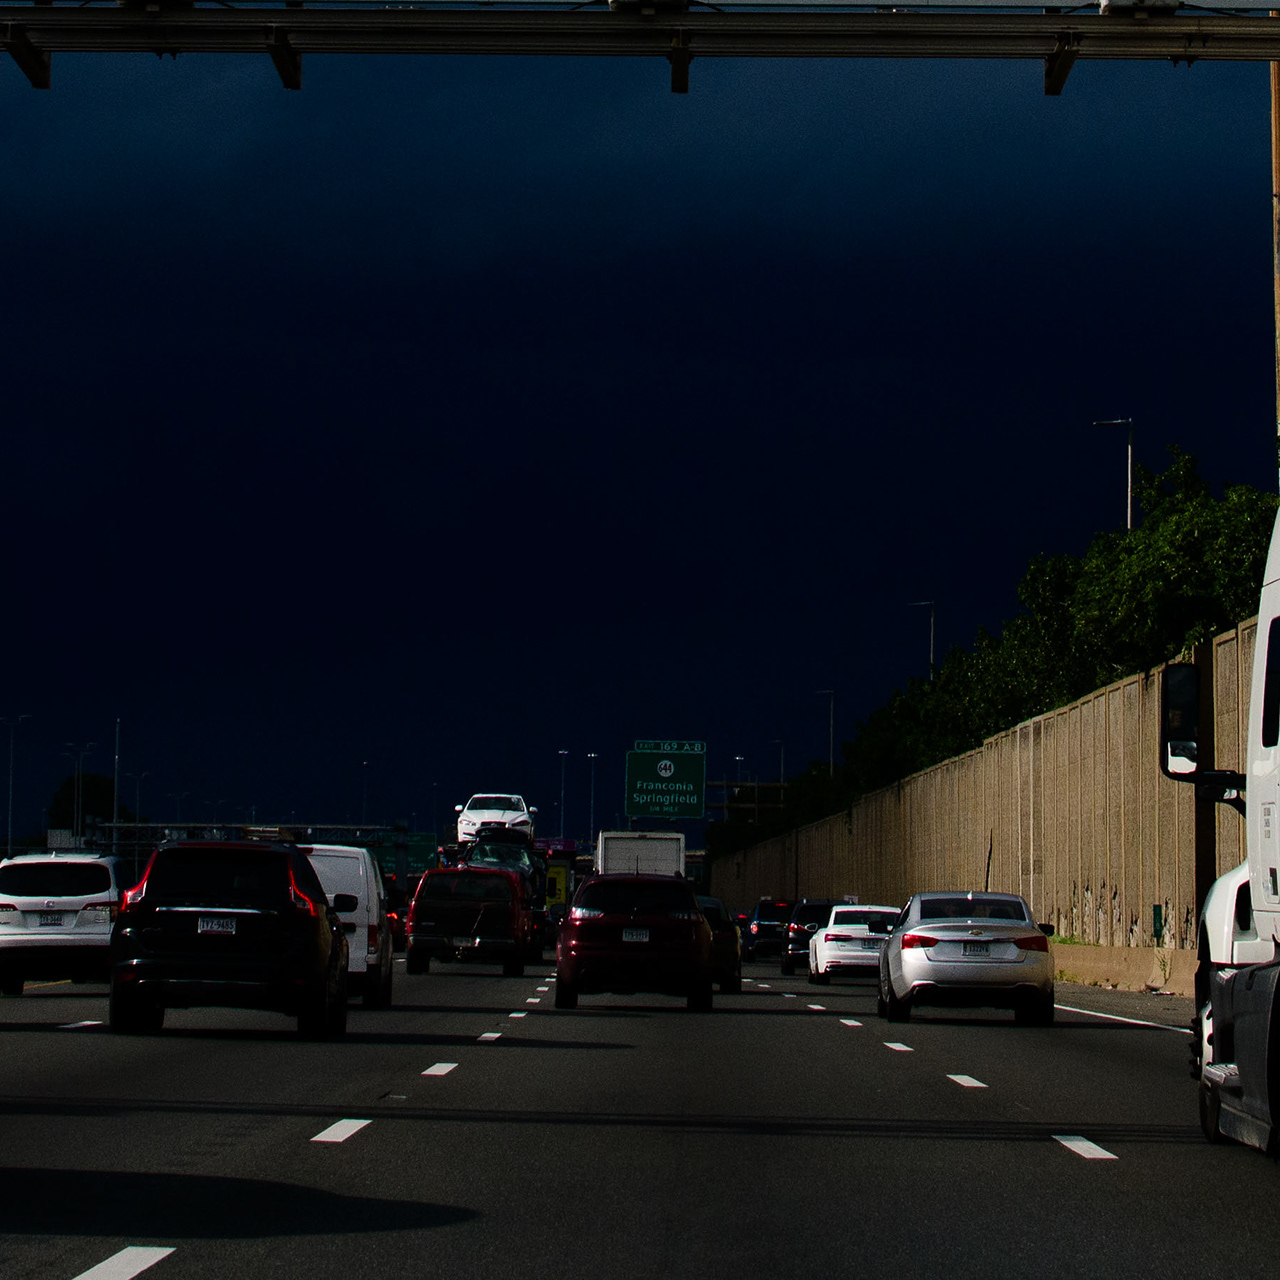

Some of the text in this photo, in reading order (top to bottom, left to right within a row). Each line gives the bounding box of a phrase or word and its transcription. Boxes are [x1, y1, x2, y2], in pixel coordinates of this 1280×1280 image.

[660, 742, 678, 751] 169
[683, 743, 702, 752] A-B
[658, 763, 672, 774] 644
[636, 781, 694, 791] Franconia
[633, 793, 698, 805] Springfield
